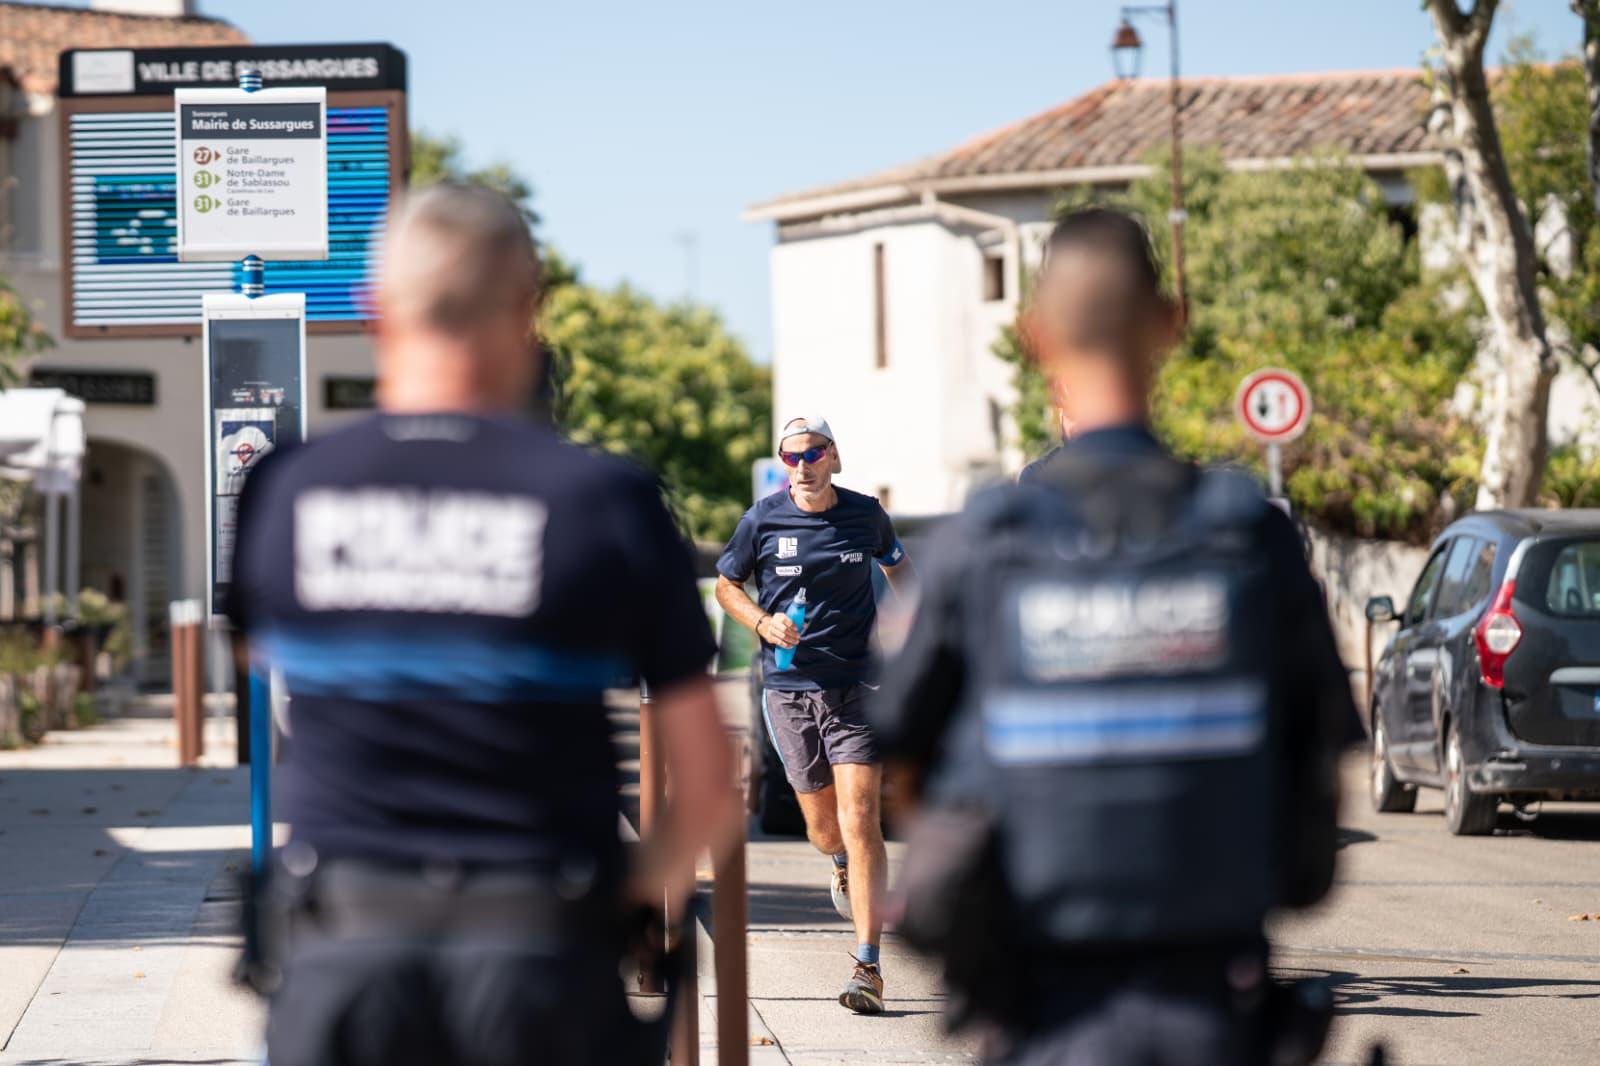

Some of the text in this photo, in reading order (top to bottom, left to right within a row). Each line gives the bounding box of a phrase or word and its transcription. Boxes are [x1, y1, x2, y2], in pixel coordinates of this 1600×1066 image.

[139, 62, 200, 82] VILLE
[201, 61, 232, 80] DE
[192, 119, 314, 132] Mairie de Sussargues
[195, 149, 209, 161] 27
[226, 146, 250, 155] Gare
[227, 156, 295, 166] de Baillargues
[227, 169, 285, 177] Notre-Dame
[195, 173, 208, 185] 31
[227, 178, 290, 187] de Sablassou
[195, 198, 208, 210] 31
[227, 198, 250, 207] Gare
[227, 208, 295, 217] de Baillargues
